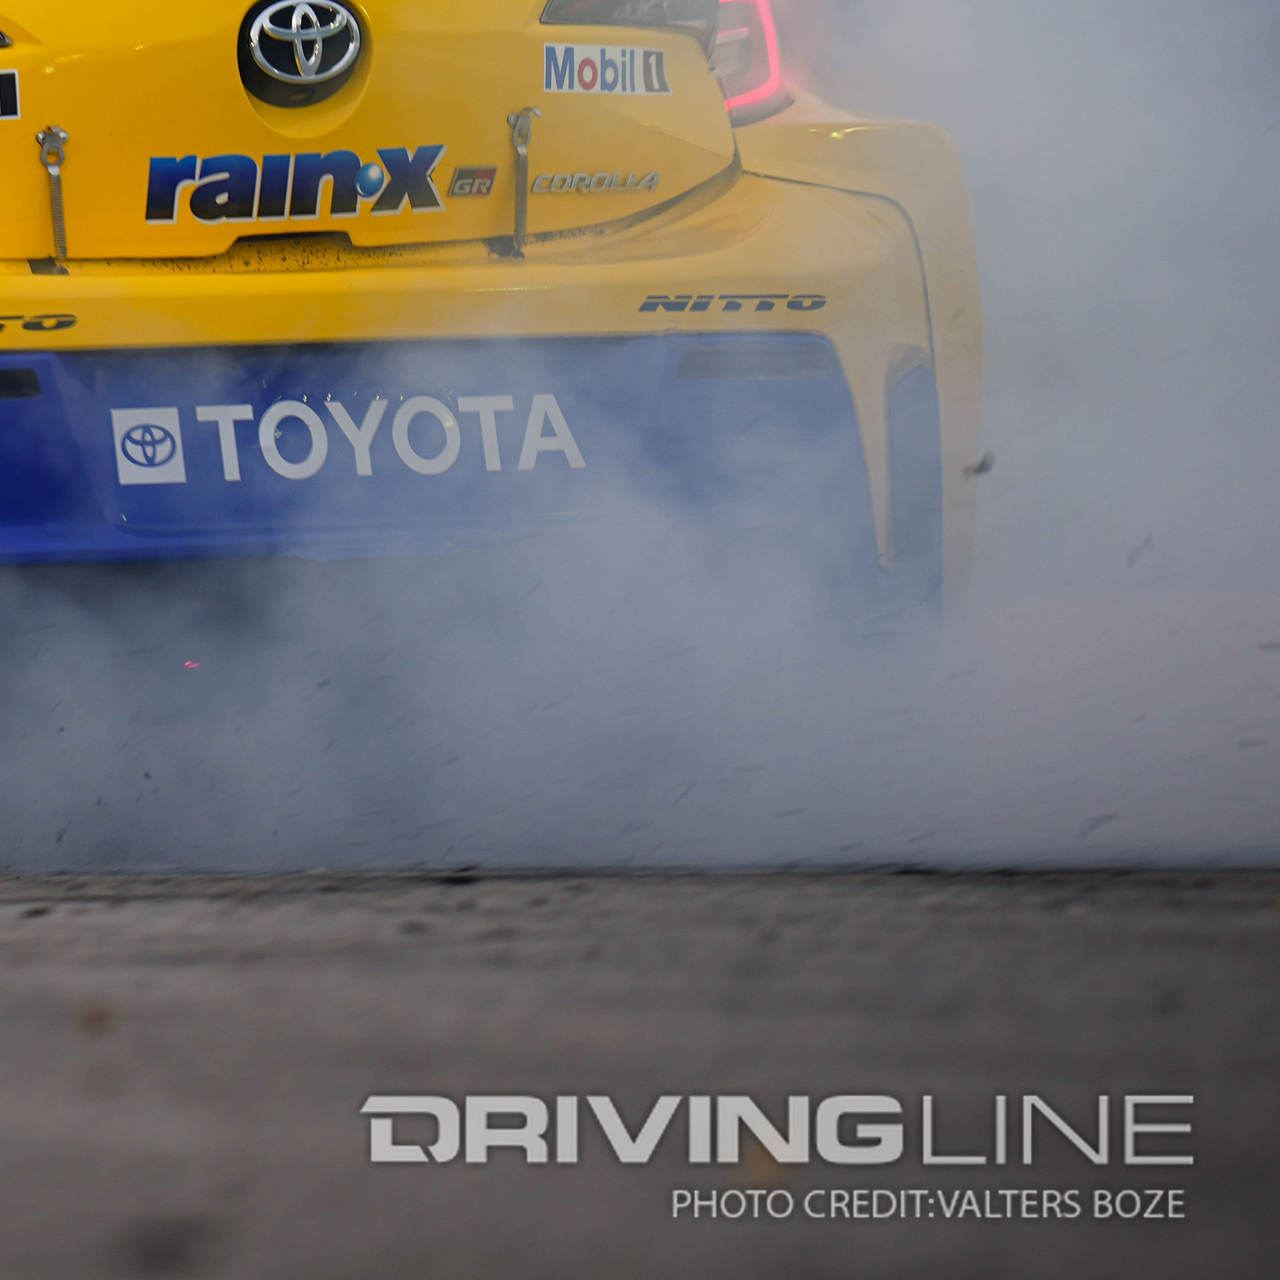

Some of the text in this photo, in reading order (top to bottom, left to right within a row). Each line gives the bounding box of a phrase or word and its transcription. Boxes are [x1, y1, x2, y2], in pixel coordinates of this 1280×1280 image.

[545, 45, 637, 93] Mobil
[531, 172, 660, 194] COROLLA
[638, 293, 828, 313] NITTO
[195, 393, 587, 481] TOYOTA
